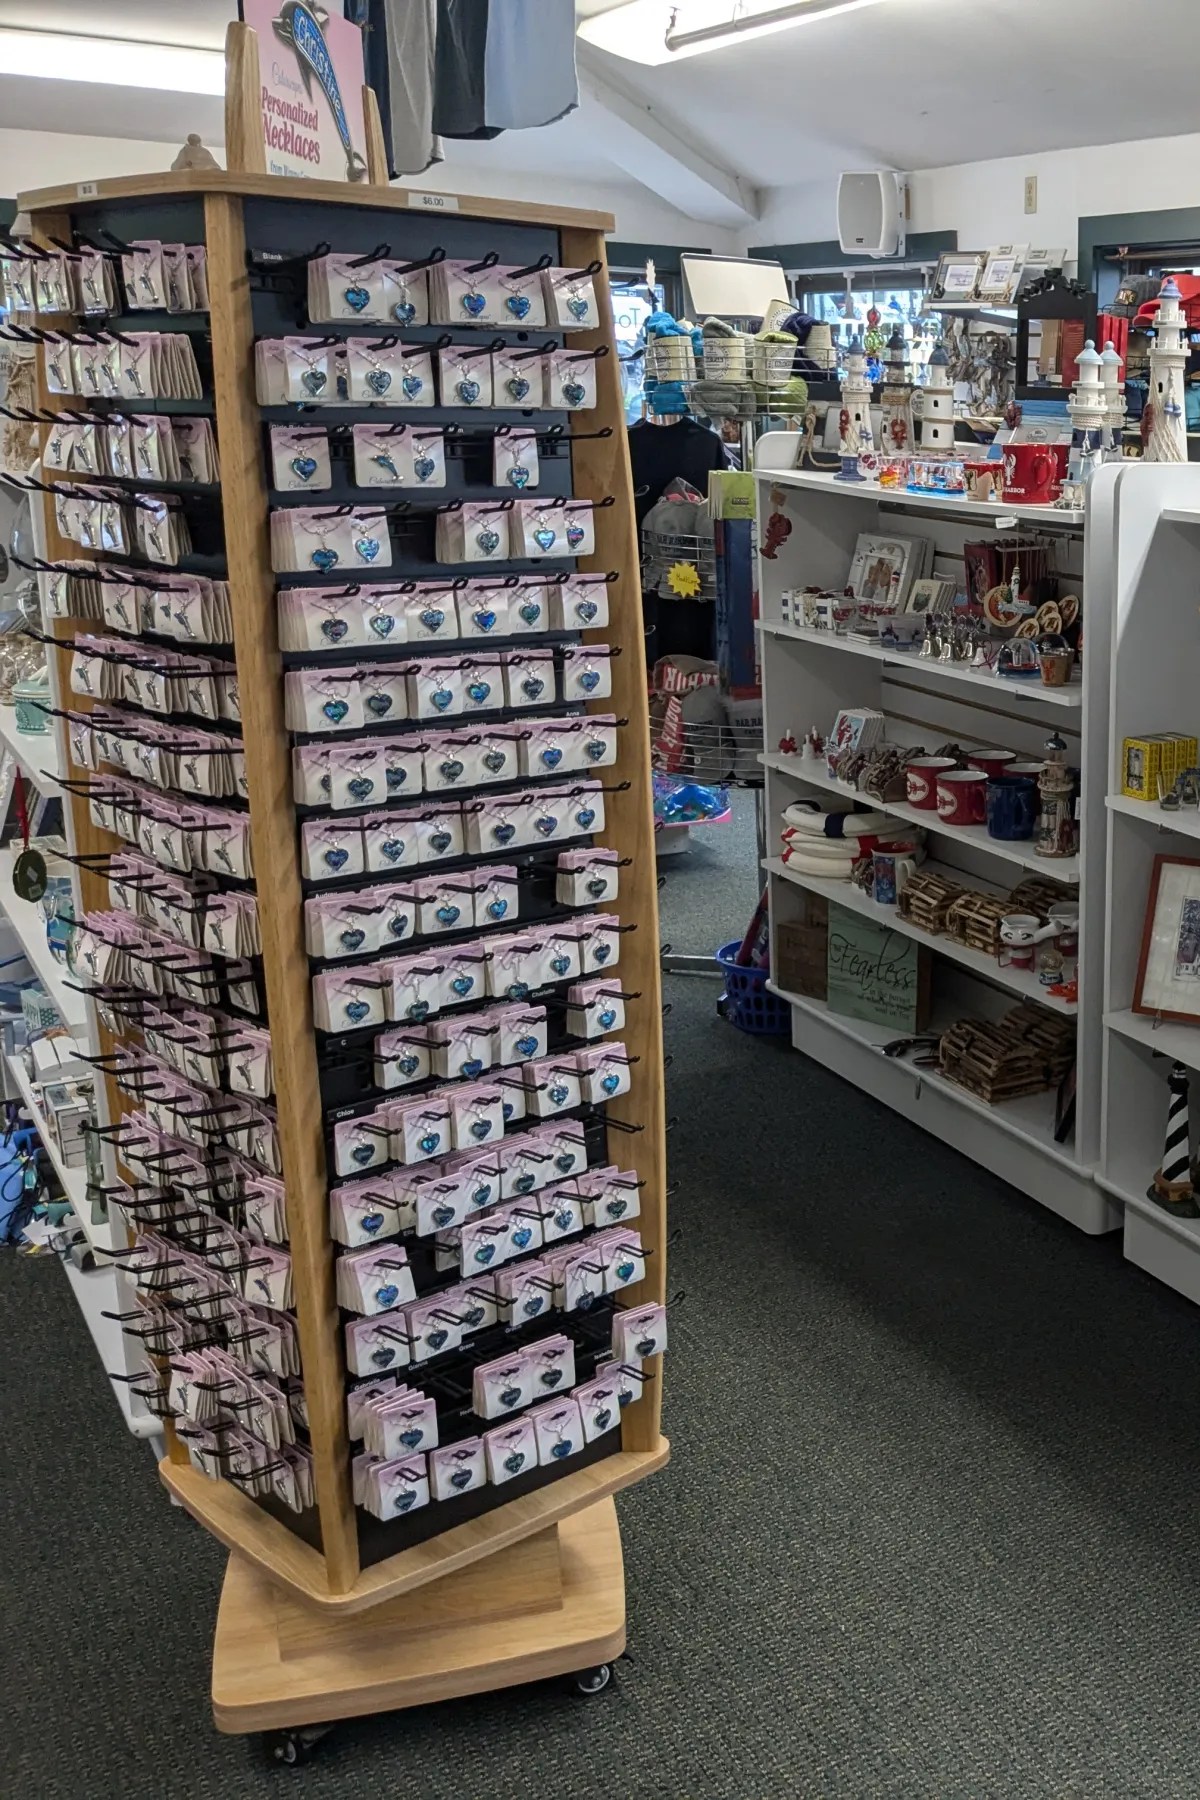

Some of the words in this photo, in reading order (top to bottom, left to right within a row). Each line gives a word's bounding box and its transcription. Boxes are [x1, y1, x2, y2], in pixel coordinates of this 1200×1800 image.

[261, 86, 319, 132] Personalized
[263, 113, 321, 165] Necklaces
[423, 196, 444, 207] $6.00
[262, 252, 283, 261] Blank
[336, 1108, 355, 1118] Chloe
